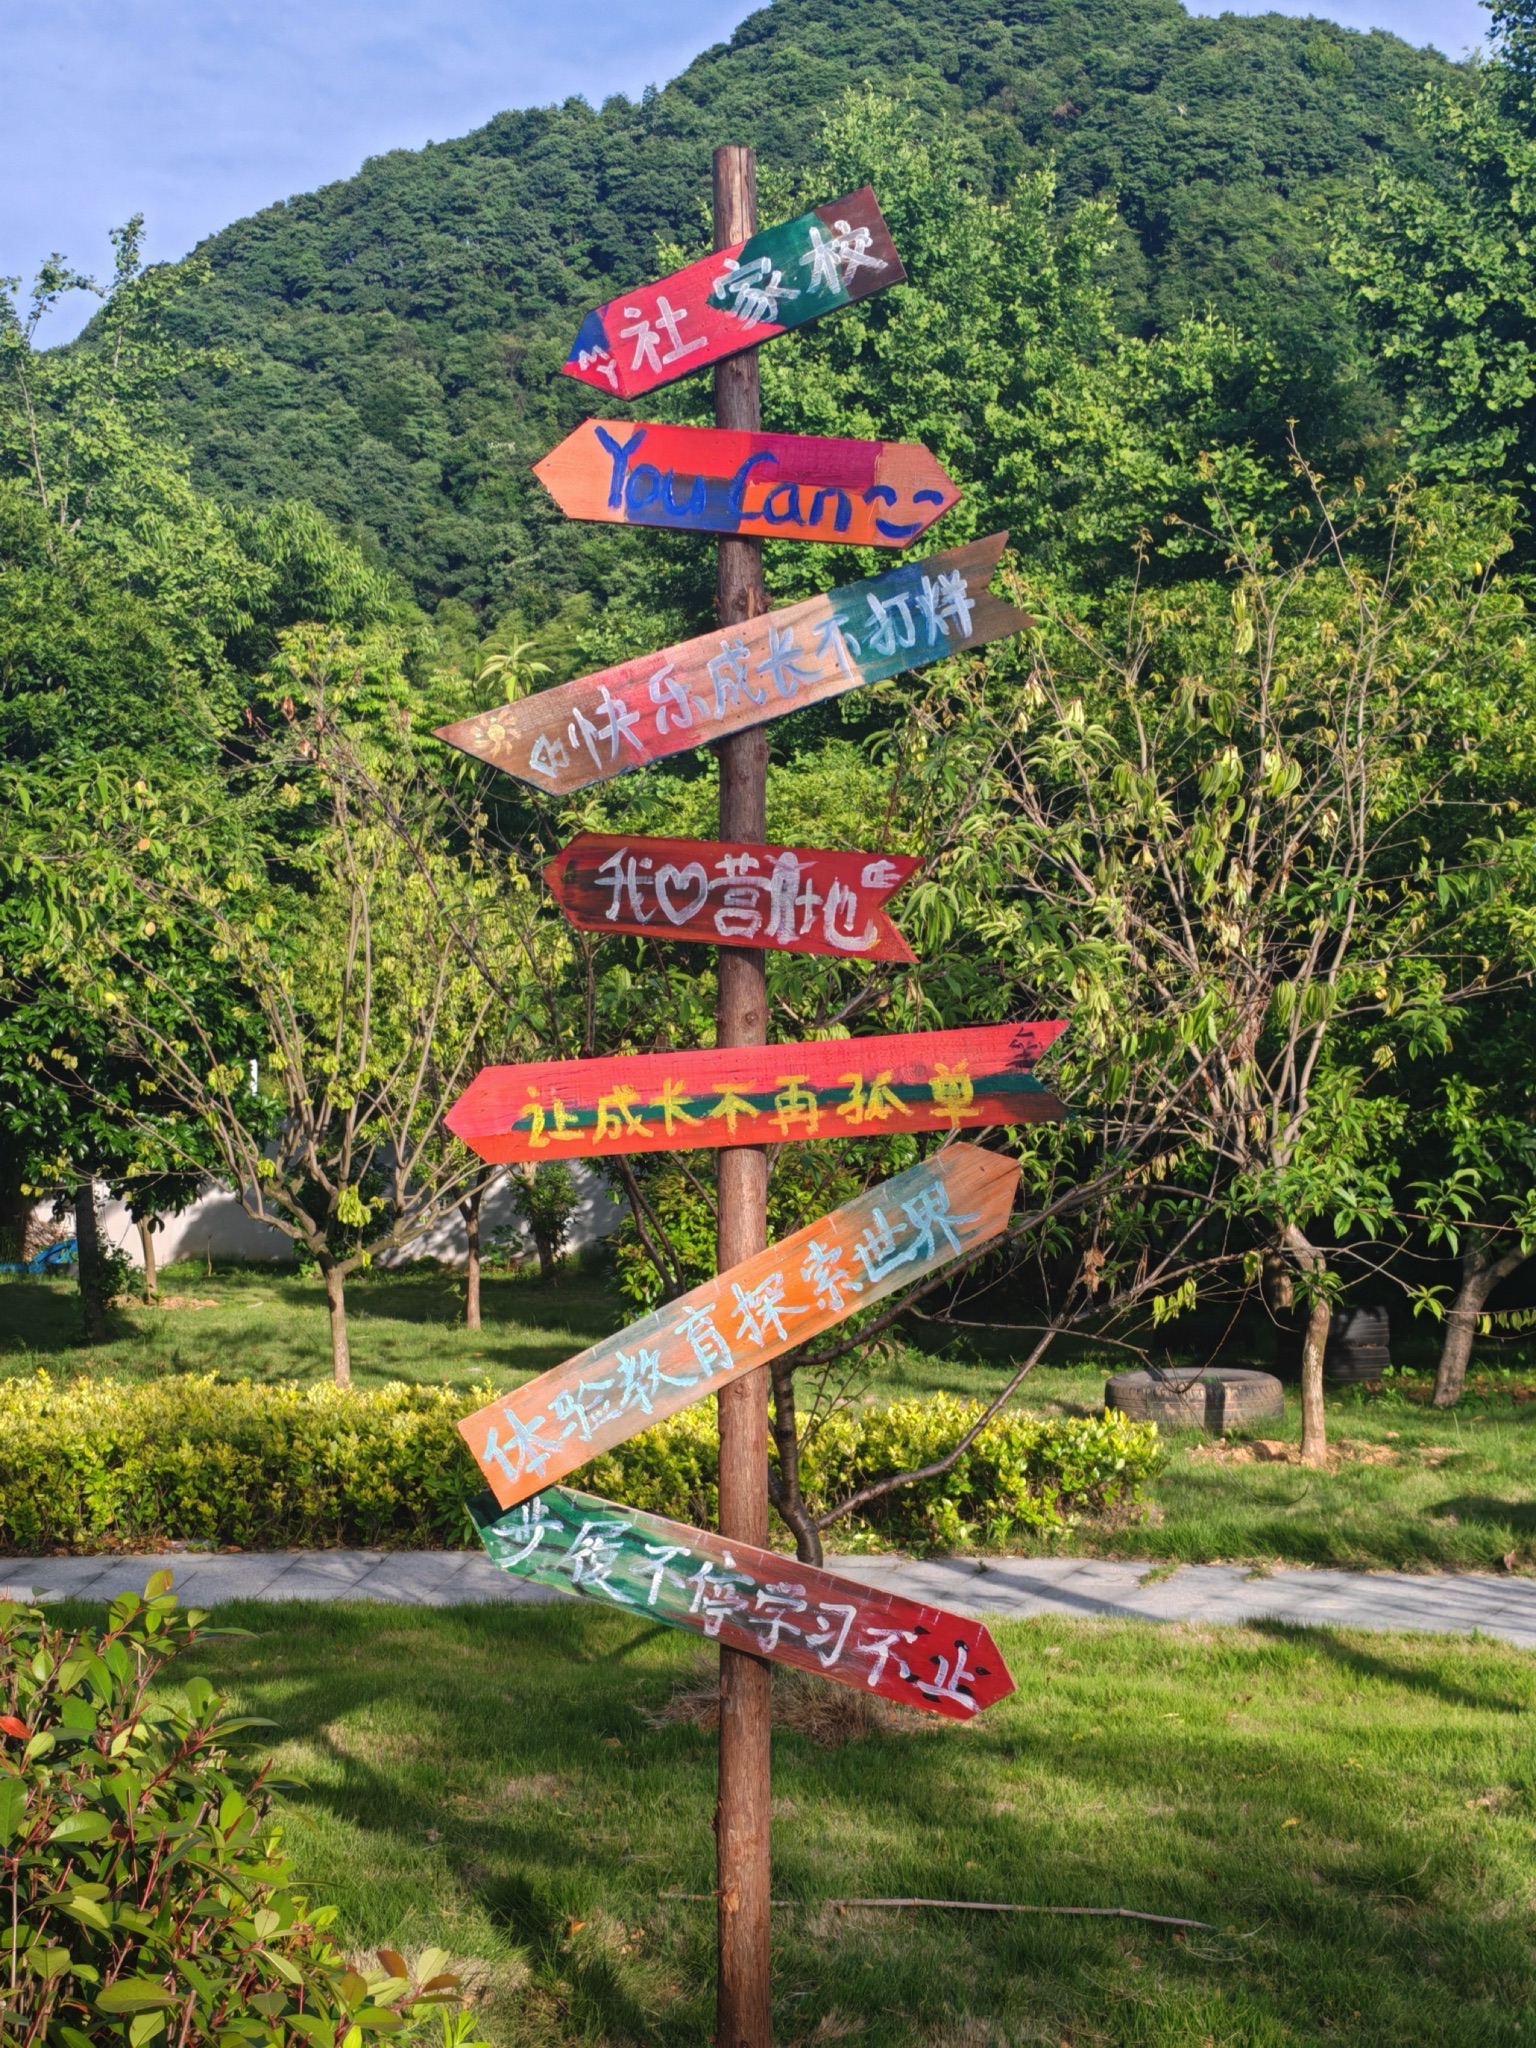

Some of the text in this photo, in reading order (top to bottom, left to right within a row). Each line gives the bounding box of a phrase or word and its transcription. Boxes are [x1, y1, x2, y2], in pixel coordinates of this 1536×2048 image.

[593, 424, 853, 533] You Can
[568, 568, 976, 771] 快乐成长不打烊
[518, 1058, 984, 1149] 让成长不再孤单
[481, 1180, 981, 1483] 体验教育探索世界
